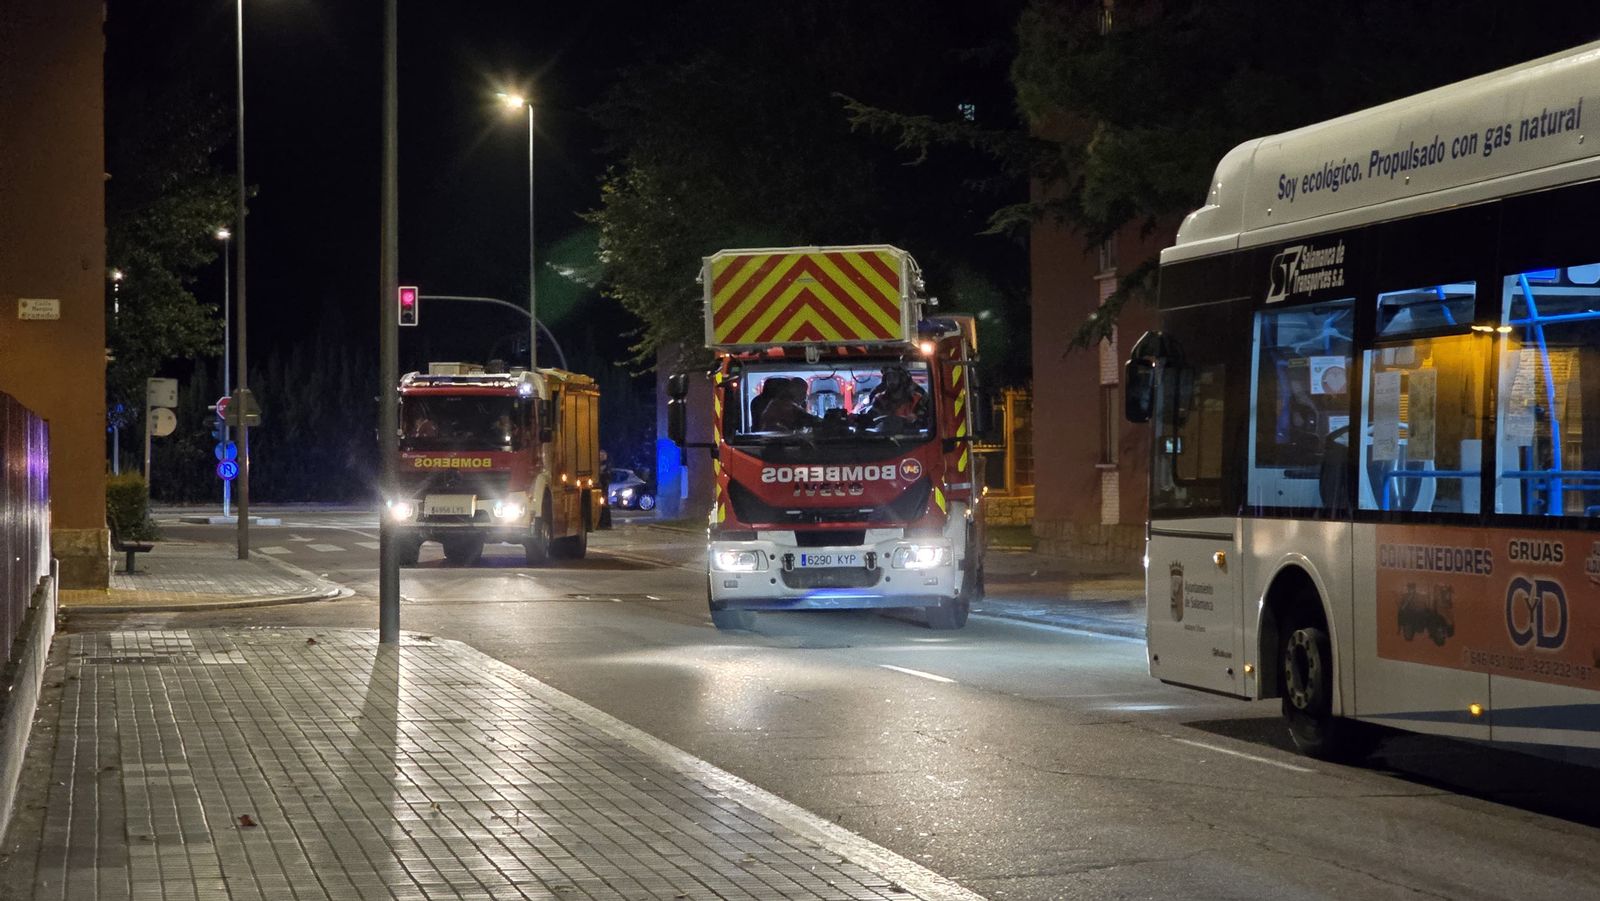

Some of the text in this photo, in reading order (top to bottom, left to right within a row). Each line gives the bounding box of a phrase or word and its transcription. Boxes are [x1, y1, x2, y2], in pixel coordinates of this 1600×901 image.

[1278, 97, 1583, 202] Soy ecológico. Propulsado con gas natural
[1301, 239, 1345, 270] Salamanca de
[1293, 268, 1345, 296] Transportes s.a.
[793, 481, 864, 497] IVECO
[808, 554, 857, 566] 6290 KYP
[1379, 544, 1494, 575] CONTENEDORES
[1508, 540, 1564, 563] GRUAS
